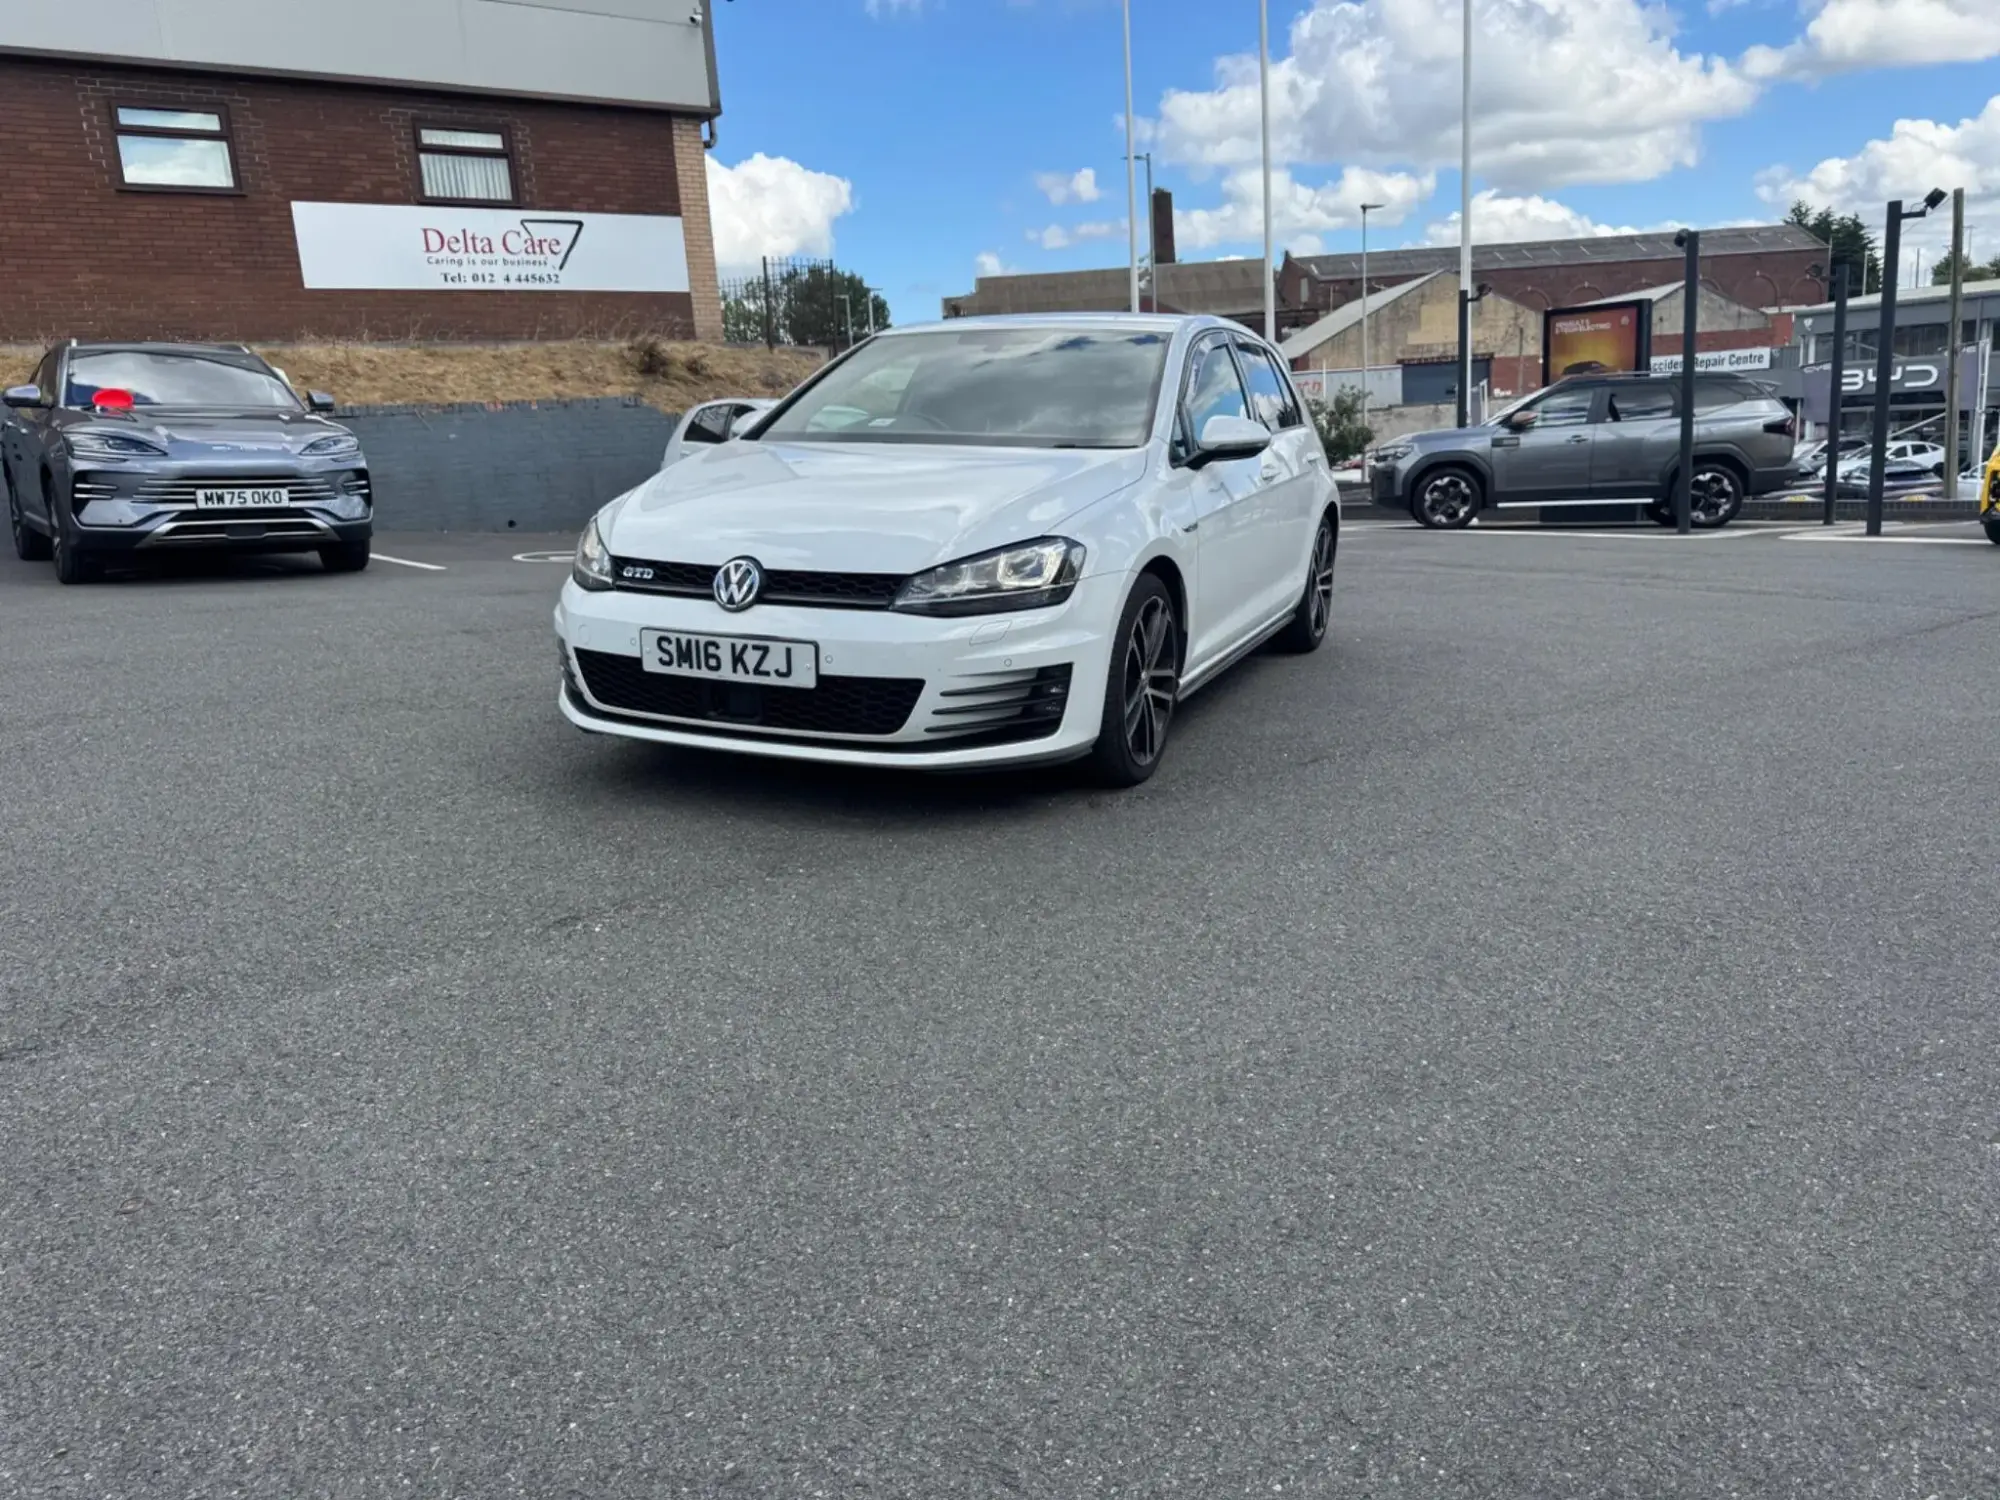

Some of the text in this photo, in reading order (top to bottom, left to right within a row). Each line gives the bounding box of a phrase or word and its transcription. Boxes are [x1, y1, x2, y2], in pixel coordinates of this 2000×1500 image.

[422, 228, 561, 255] Delta Care
[427, 256, 548, 267] Caring is our business
[441, 272, 467, 283] Tel:
[515, 273, 560, 284] 445632
[1694, 355, 1726, 370] Repair
[1728, 353, 1765, 366] Centre
[203, 491, 247, 505] MW75
[622, 566, 654, 579] GTD
[656, 635, 792, 679] SM16 KZJ
